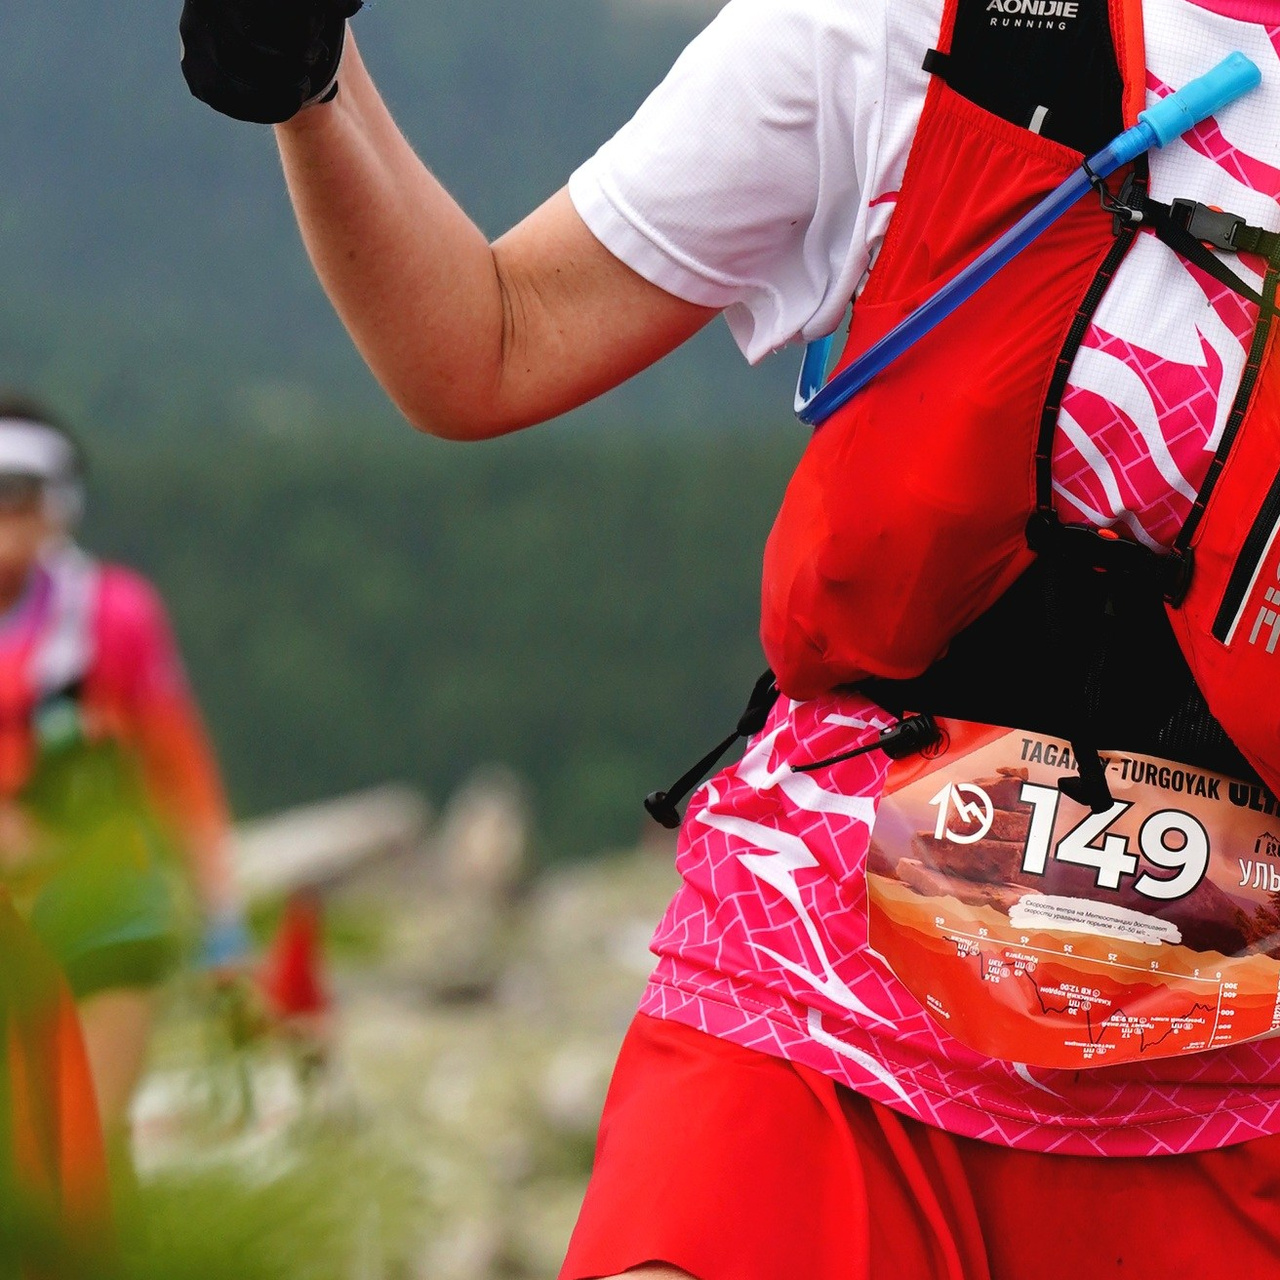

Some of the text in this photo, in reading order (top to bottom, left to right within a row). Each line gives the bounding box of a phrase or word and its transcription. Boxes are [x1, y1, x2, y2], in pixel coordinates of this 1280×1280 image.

[990, 17, 1066, 30] RUNNING
[1019, 782, 1210, 900] 149
[1025, 899, 1055, 911] Скорость
[1056, 905, 1076, 916] ветра
[1024, 908, 1053, 918] скорости
[935, 916, 945, 925] 65
[979, 927, 989, 937] 55
[1020, 935, 1030, 945] 45
[1064, 944, 1073, 953] 35
[1108, 953, 1118, 961] 25
[1014, 961, 1026, 969] ПП
[1151, 961, 1159, 969] 15
[988, 966, 1000, 975] ПП
[1194, 969, 1199, 977] 5
[1216, 971, 1222, 979] 0
[1060, 983, 1092, 995] КВ 12:00
